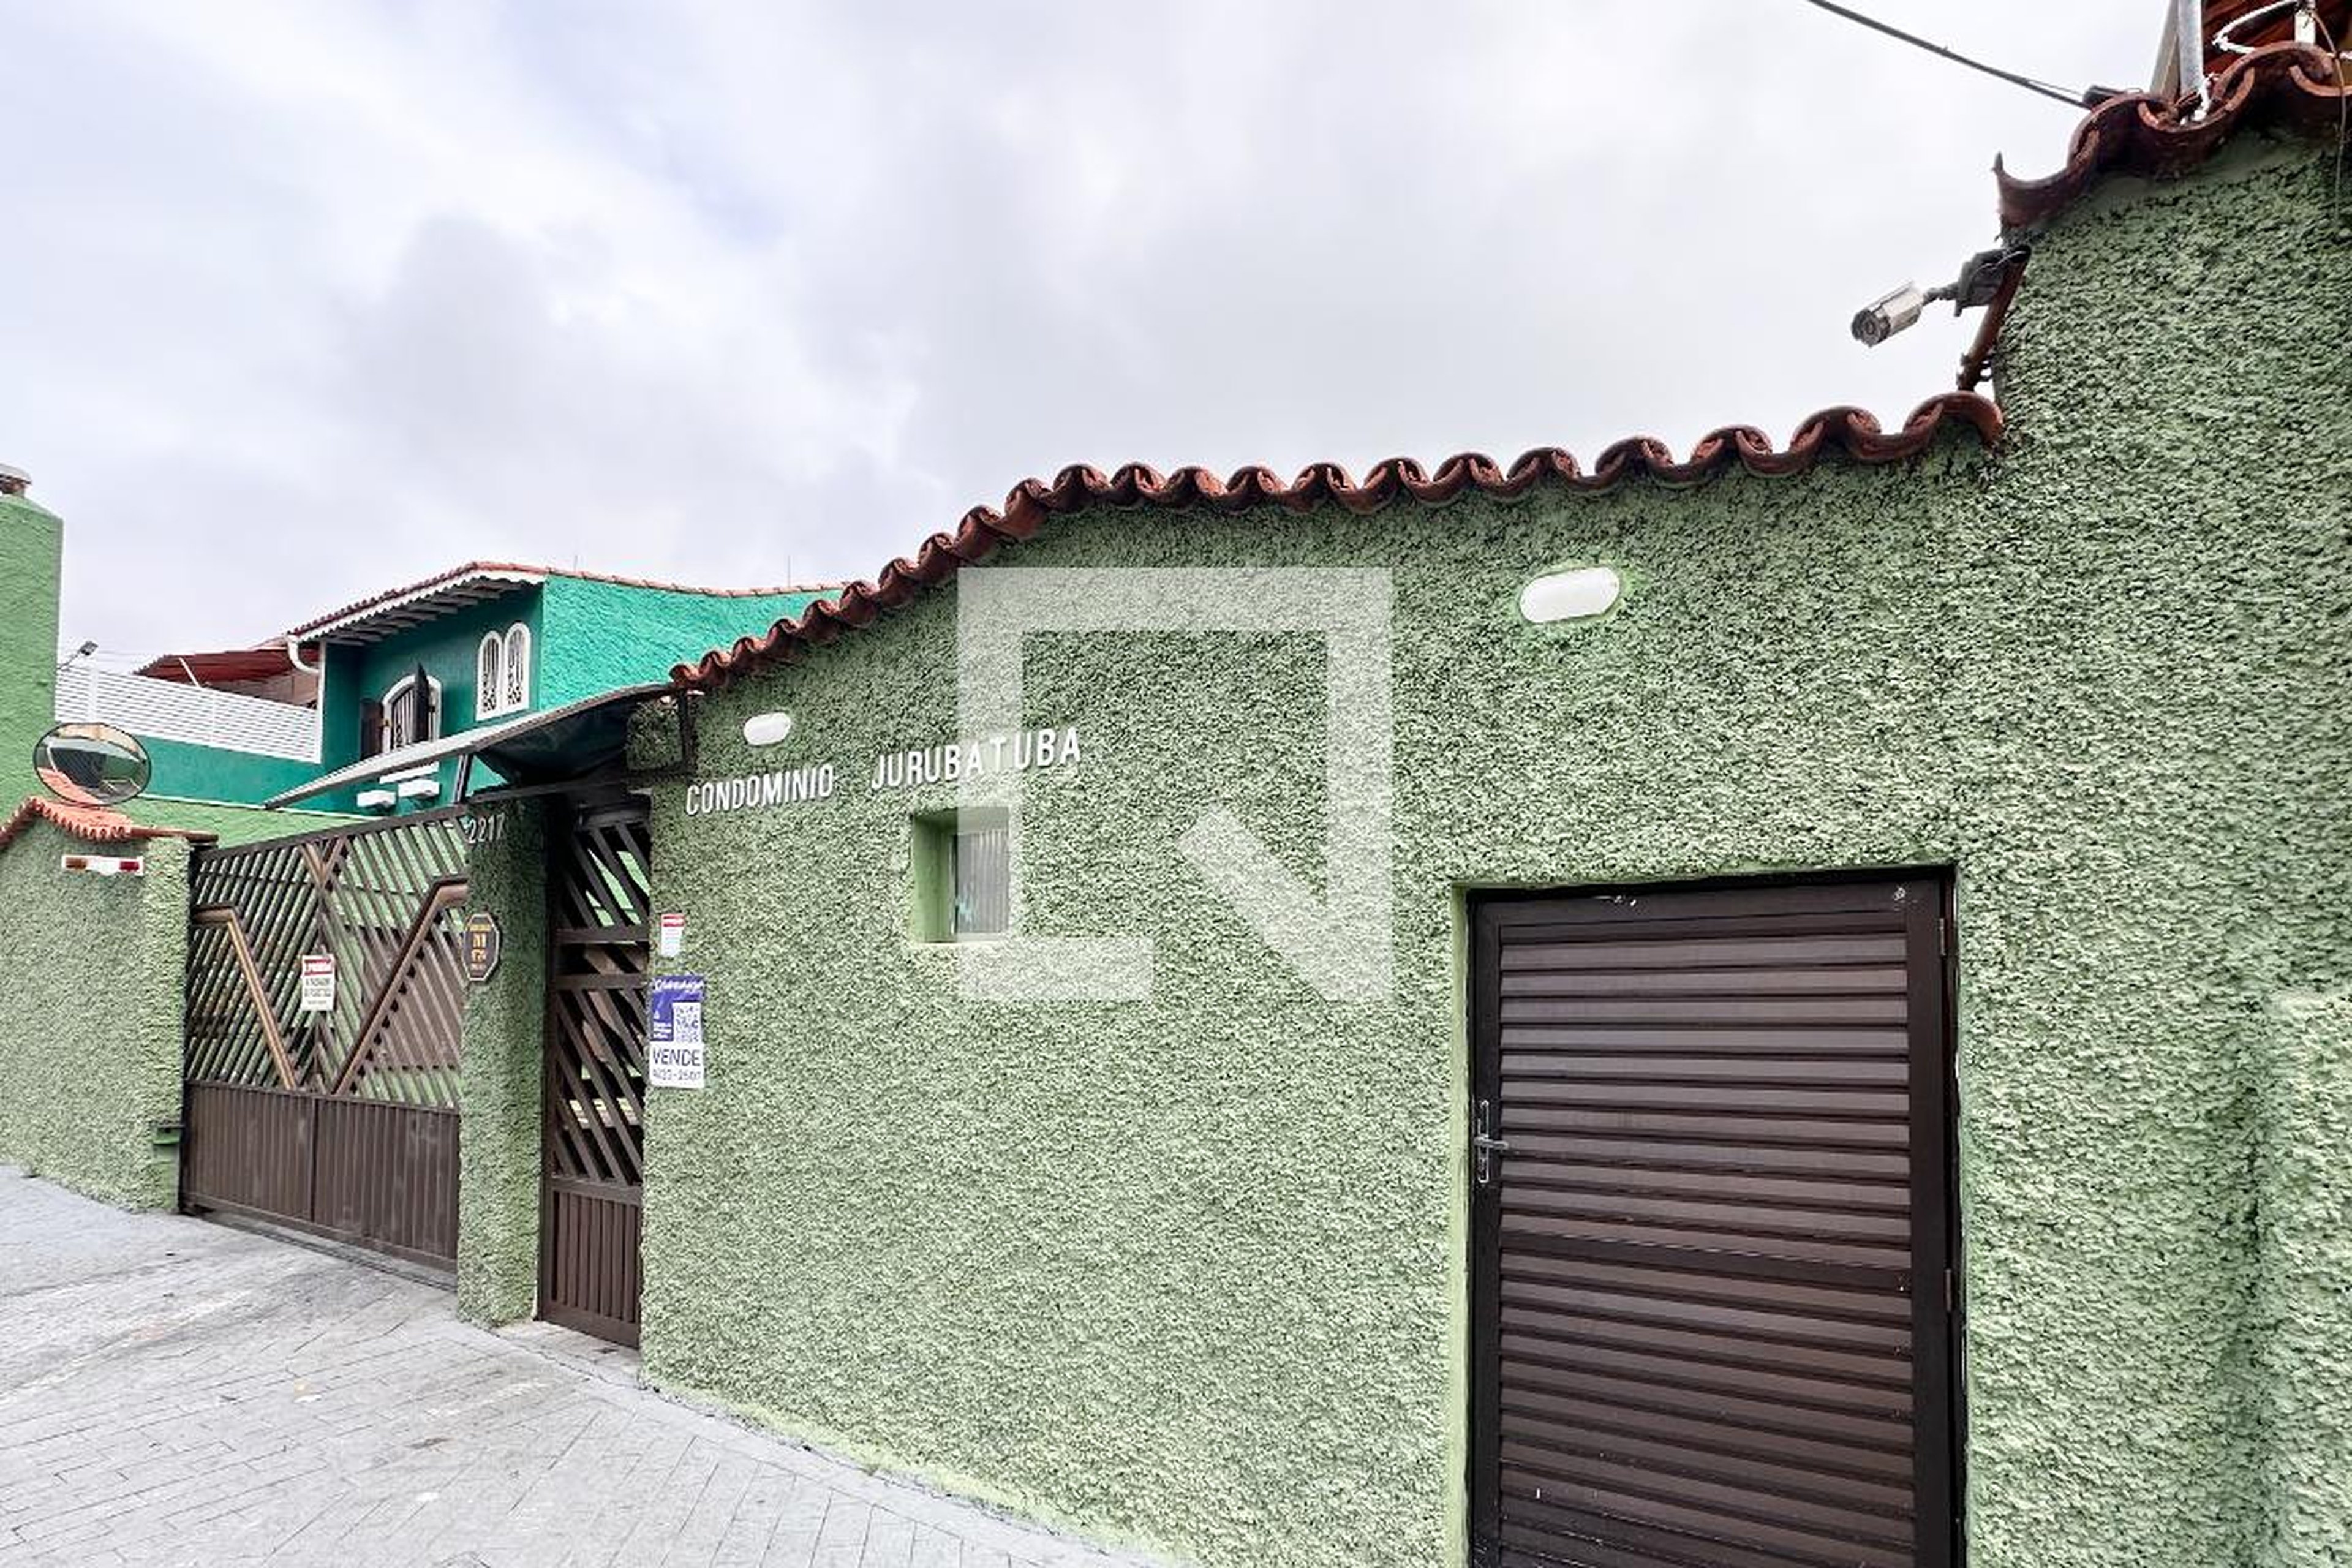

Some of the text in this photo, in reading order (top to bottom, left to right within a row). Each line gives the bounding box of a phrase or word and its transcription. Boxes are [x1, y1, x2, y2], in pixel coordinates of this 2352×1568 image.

[685, 726, 1082, 816] CONDOMINIO JURUBATUBA
[466, 812, 505, 843] 2217
[652, 1048, 701, 1066] VENDE
